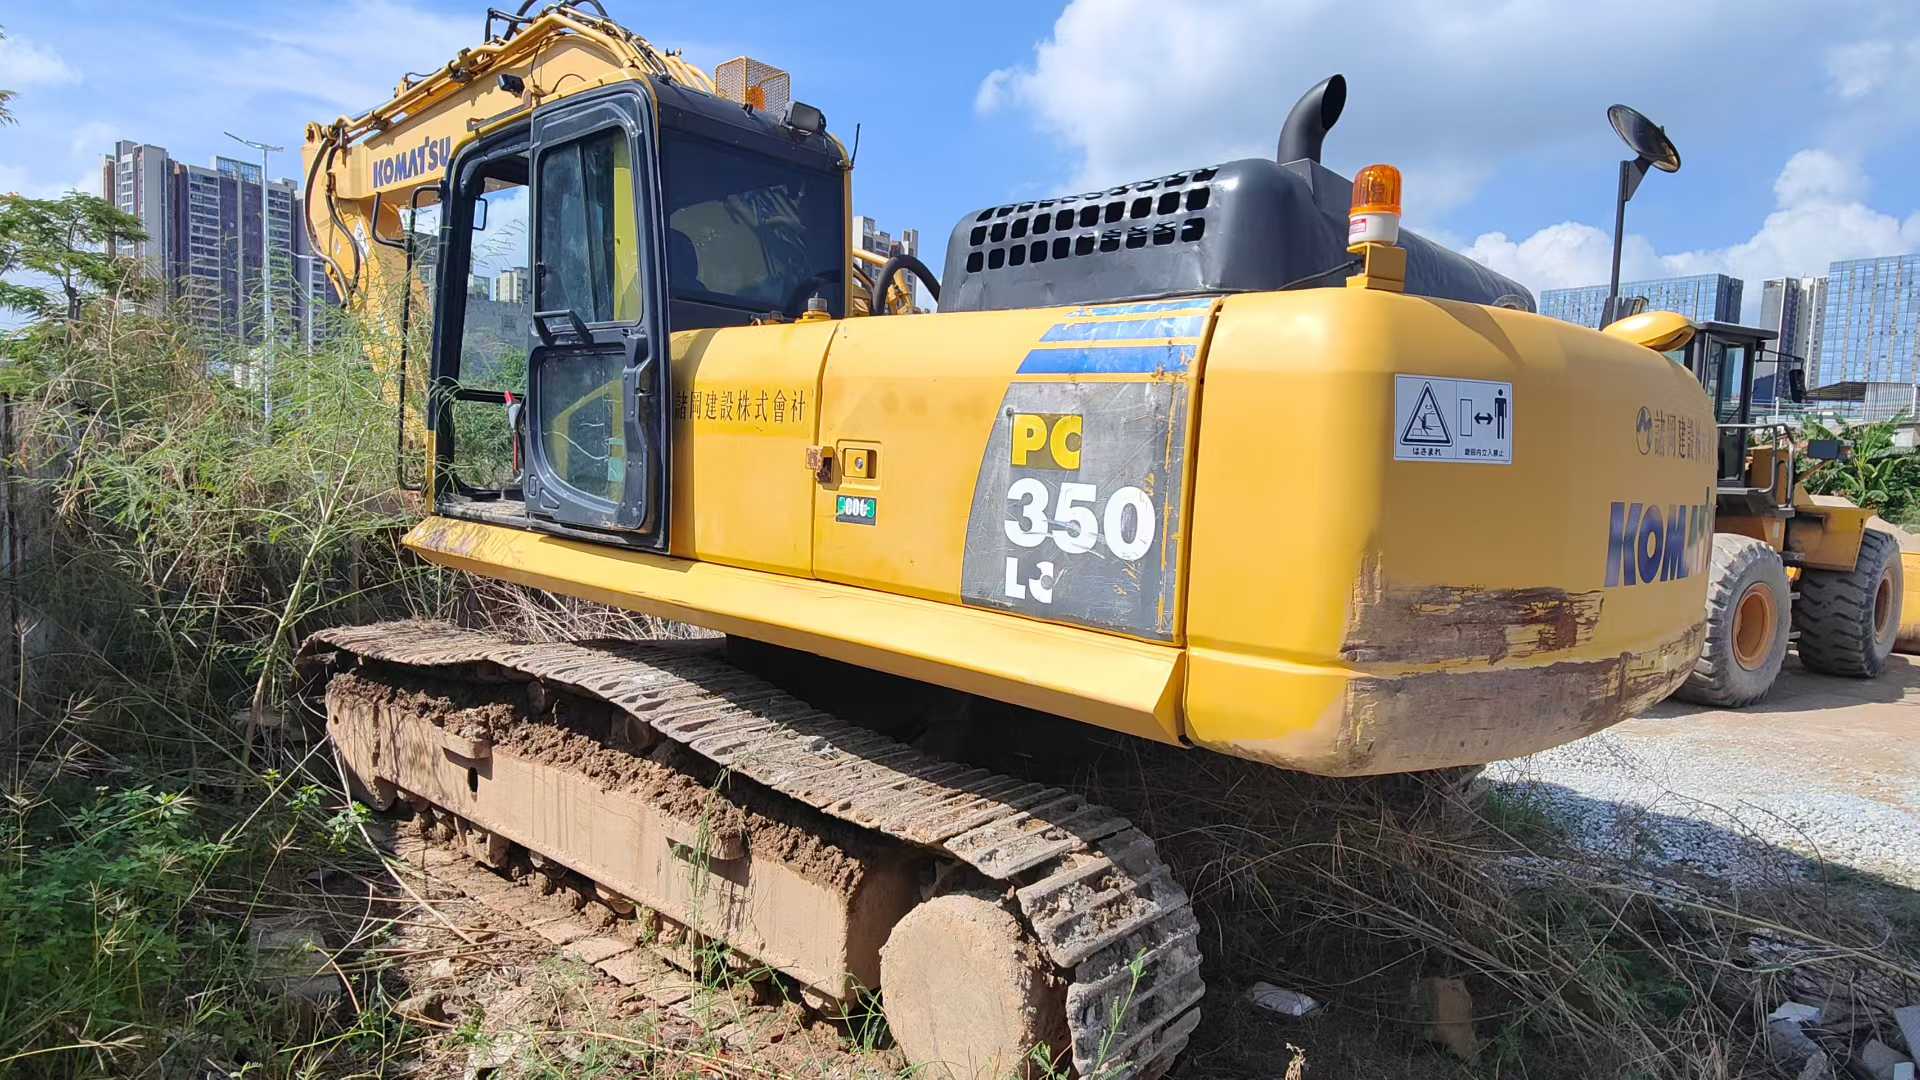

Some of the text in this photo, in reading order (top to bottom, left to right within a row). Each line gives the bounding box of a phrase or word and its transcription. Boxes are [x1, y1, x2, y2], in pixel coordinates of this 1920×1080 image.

[373, 136, 451, 188] KOMATSU
[1011, 414, 1083, 471] PC
[1004, 477, 1156, 561] 350
